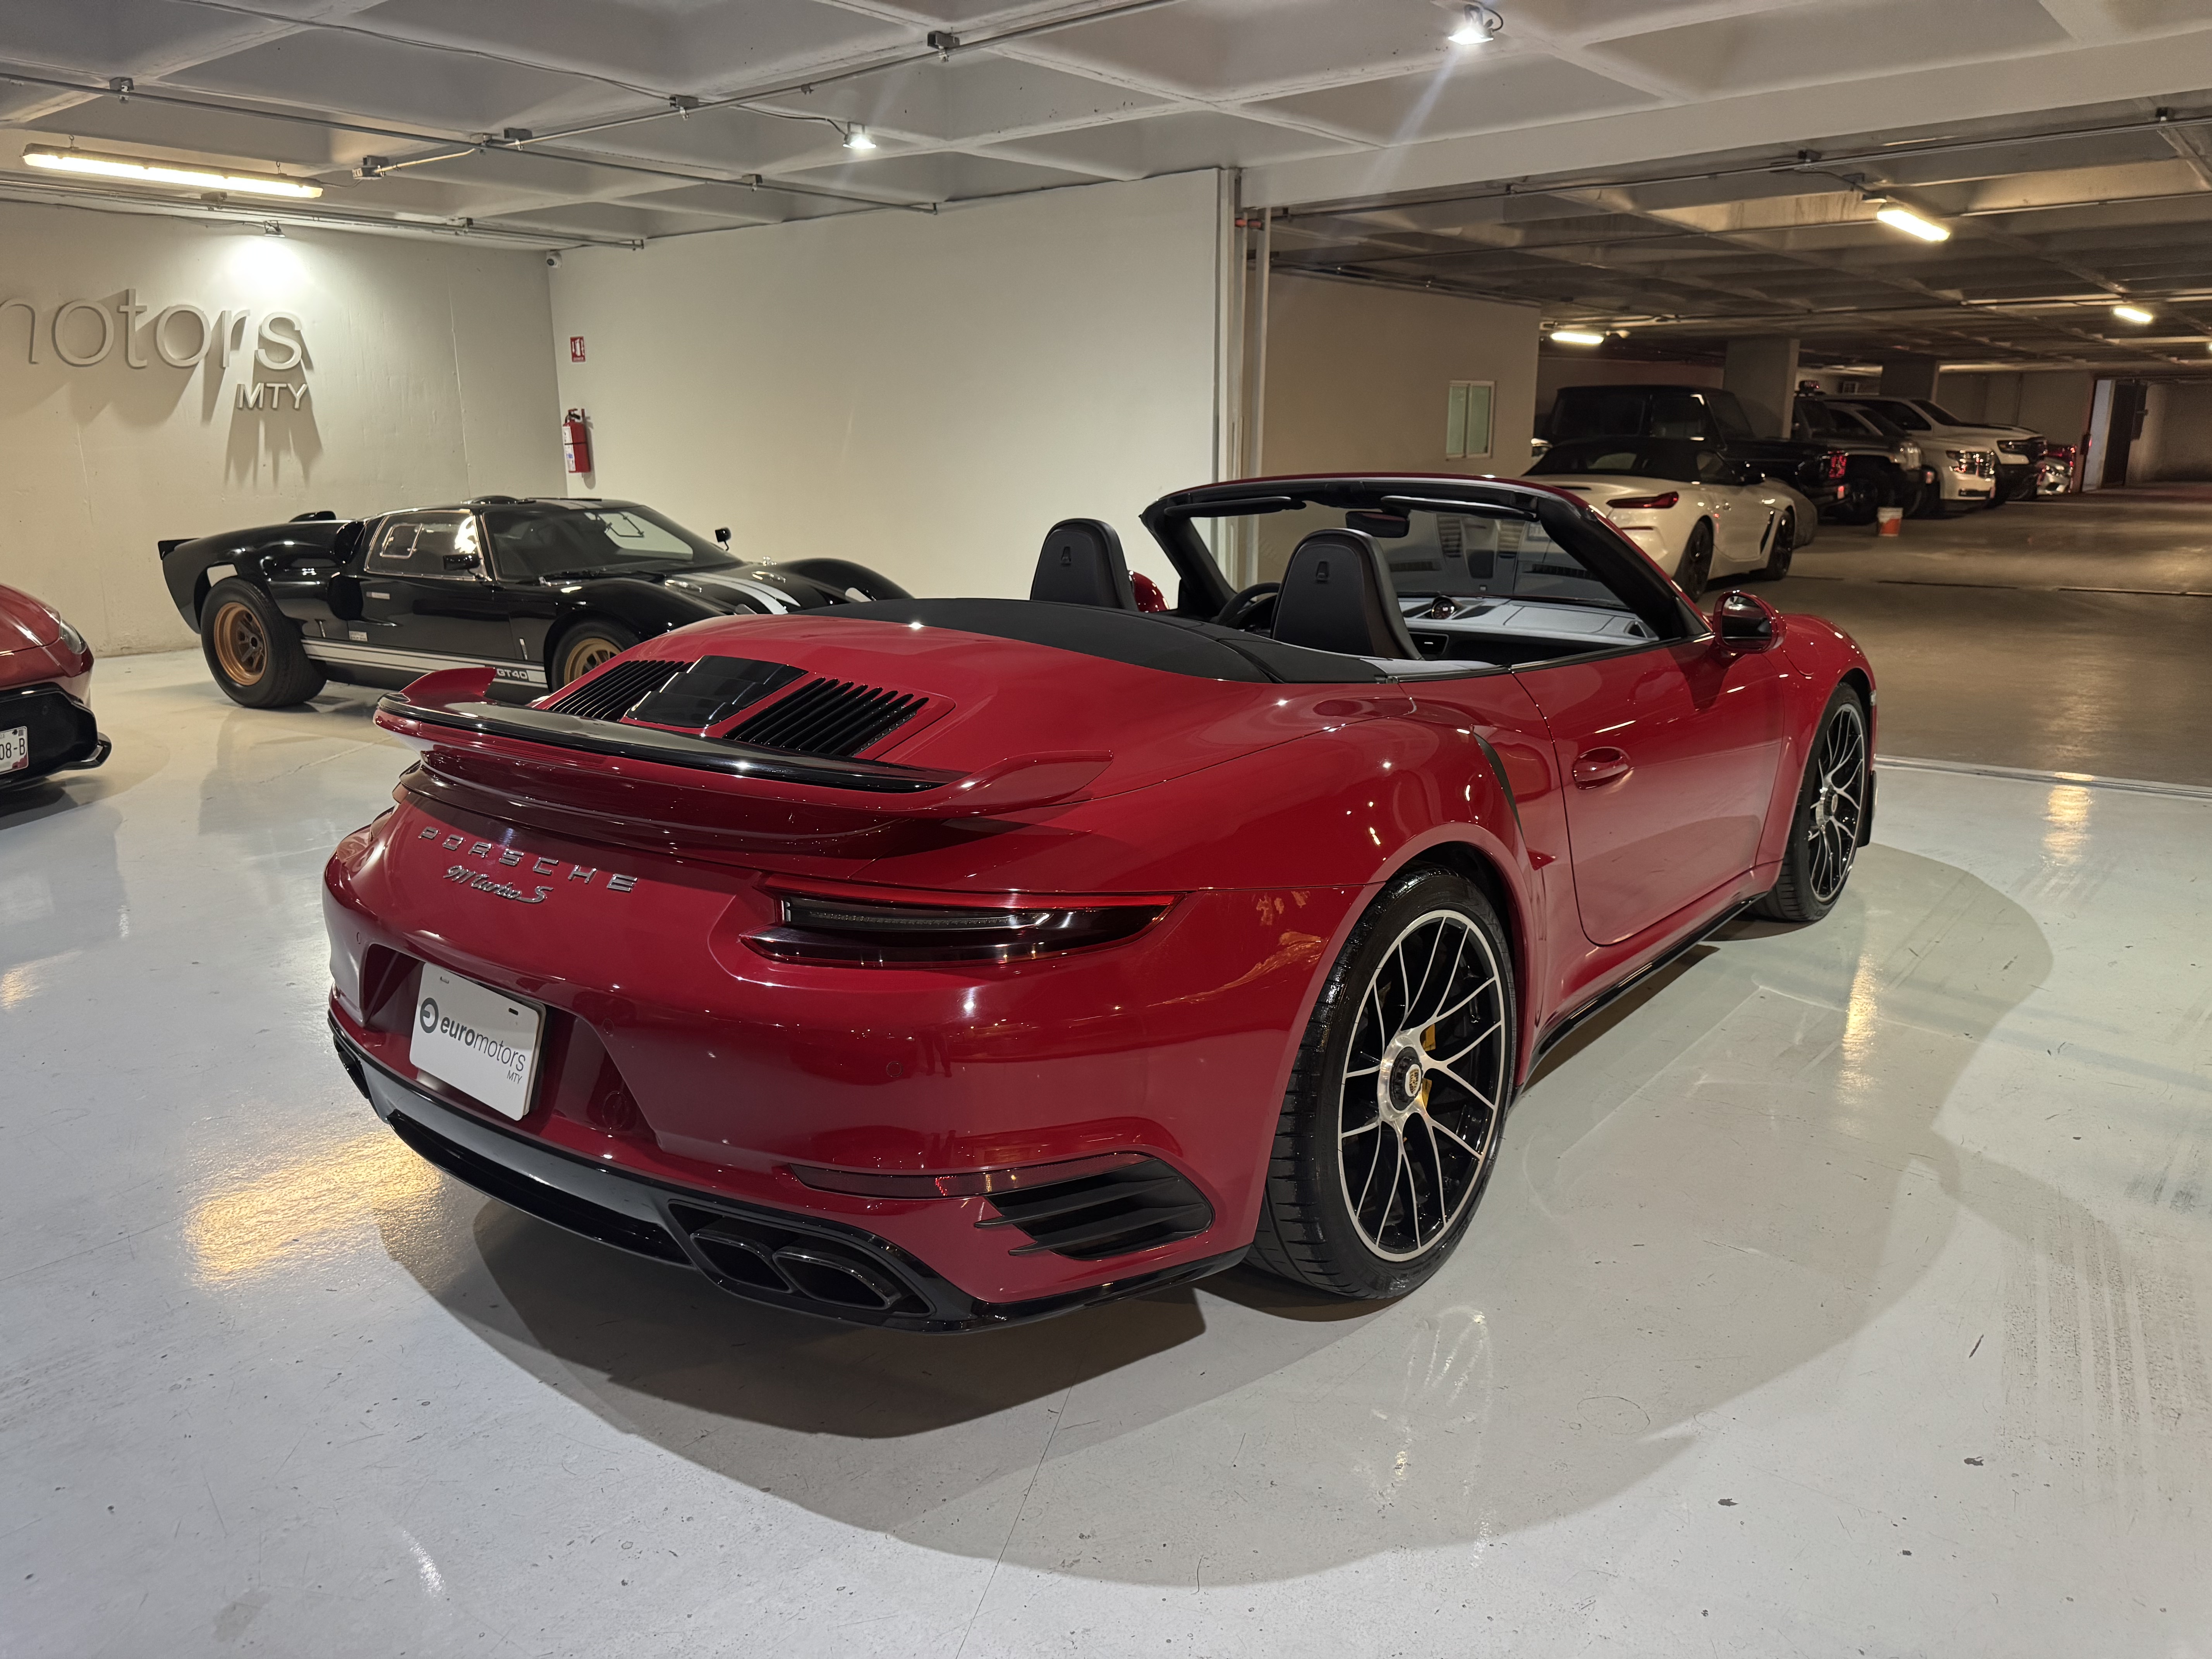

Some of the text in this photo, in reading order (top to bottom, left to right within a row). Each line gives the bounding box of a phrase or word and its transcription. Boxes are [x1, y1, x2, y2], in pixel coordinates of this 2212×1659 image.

[236, 382, 308, 409] MTY
[496, 668, 527, 680] GT40
[418, 826, 638, 893] PORSCHE
[443, 865, 476, 884] 911
[516, 886, 554, 903] S
[440, 1017, 526, 1076] euromotors
[507, 1070, 523, 1084] MTY
